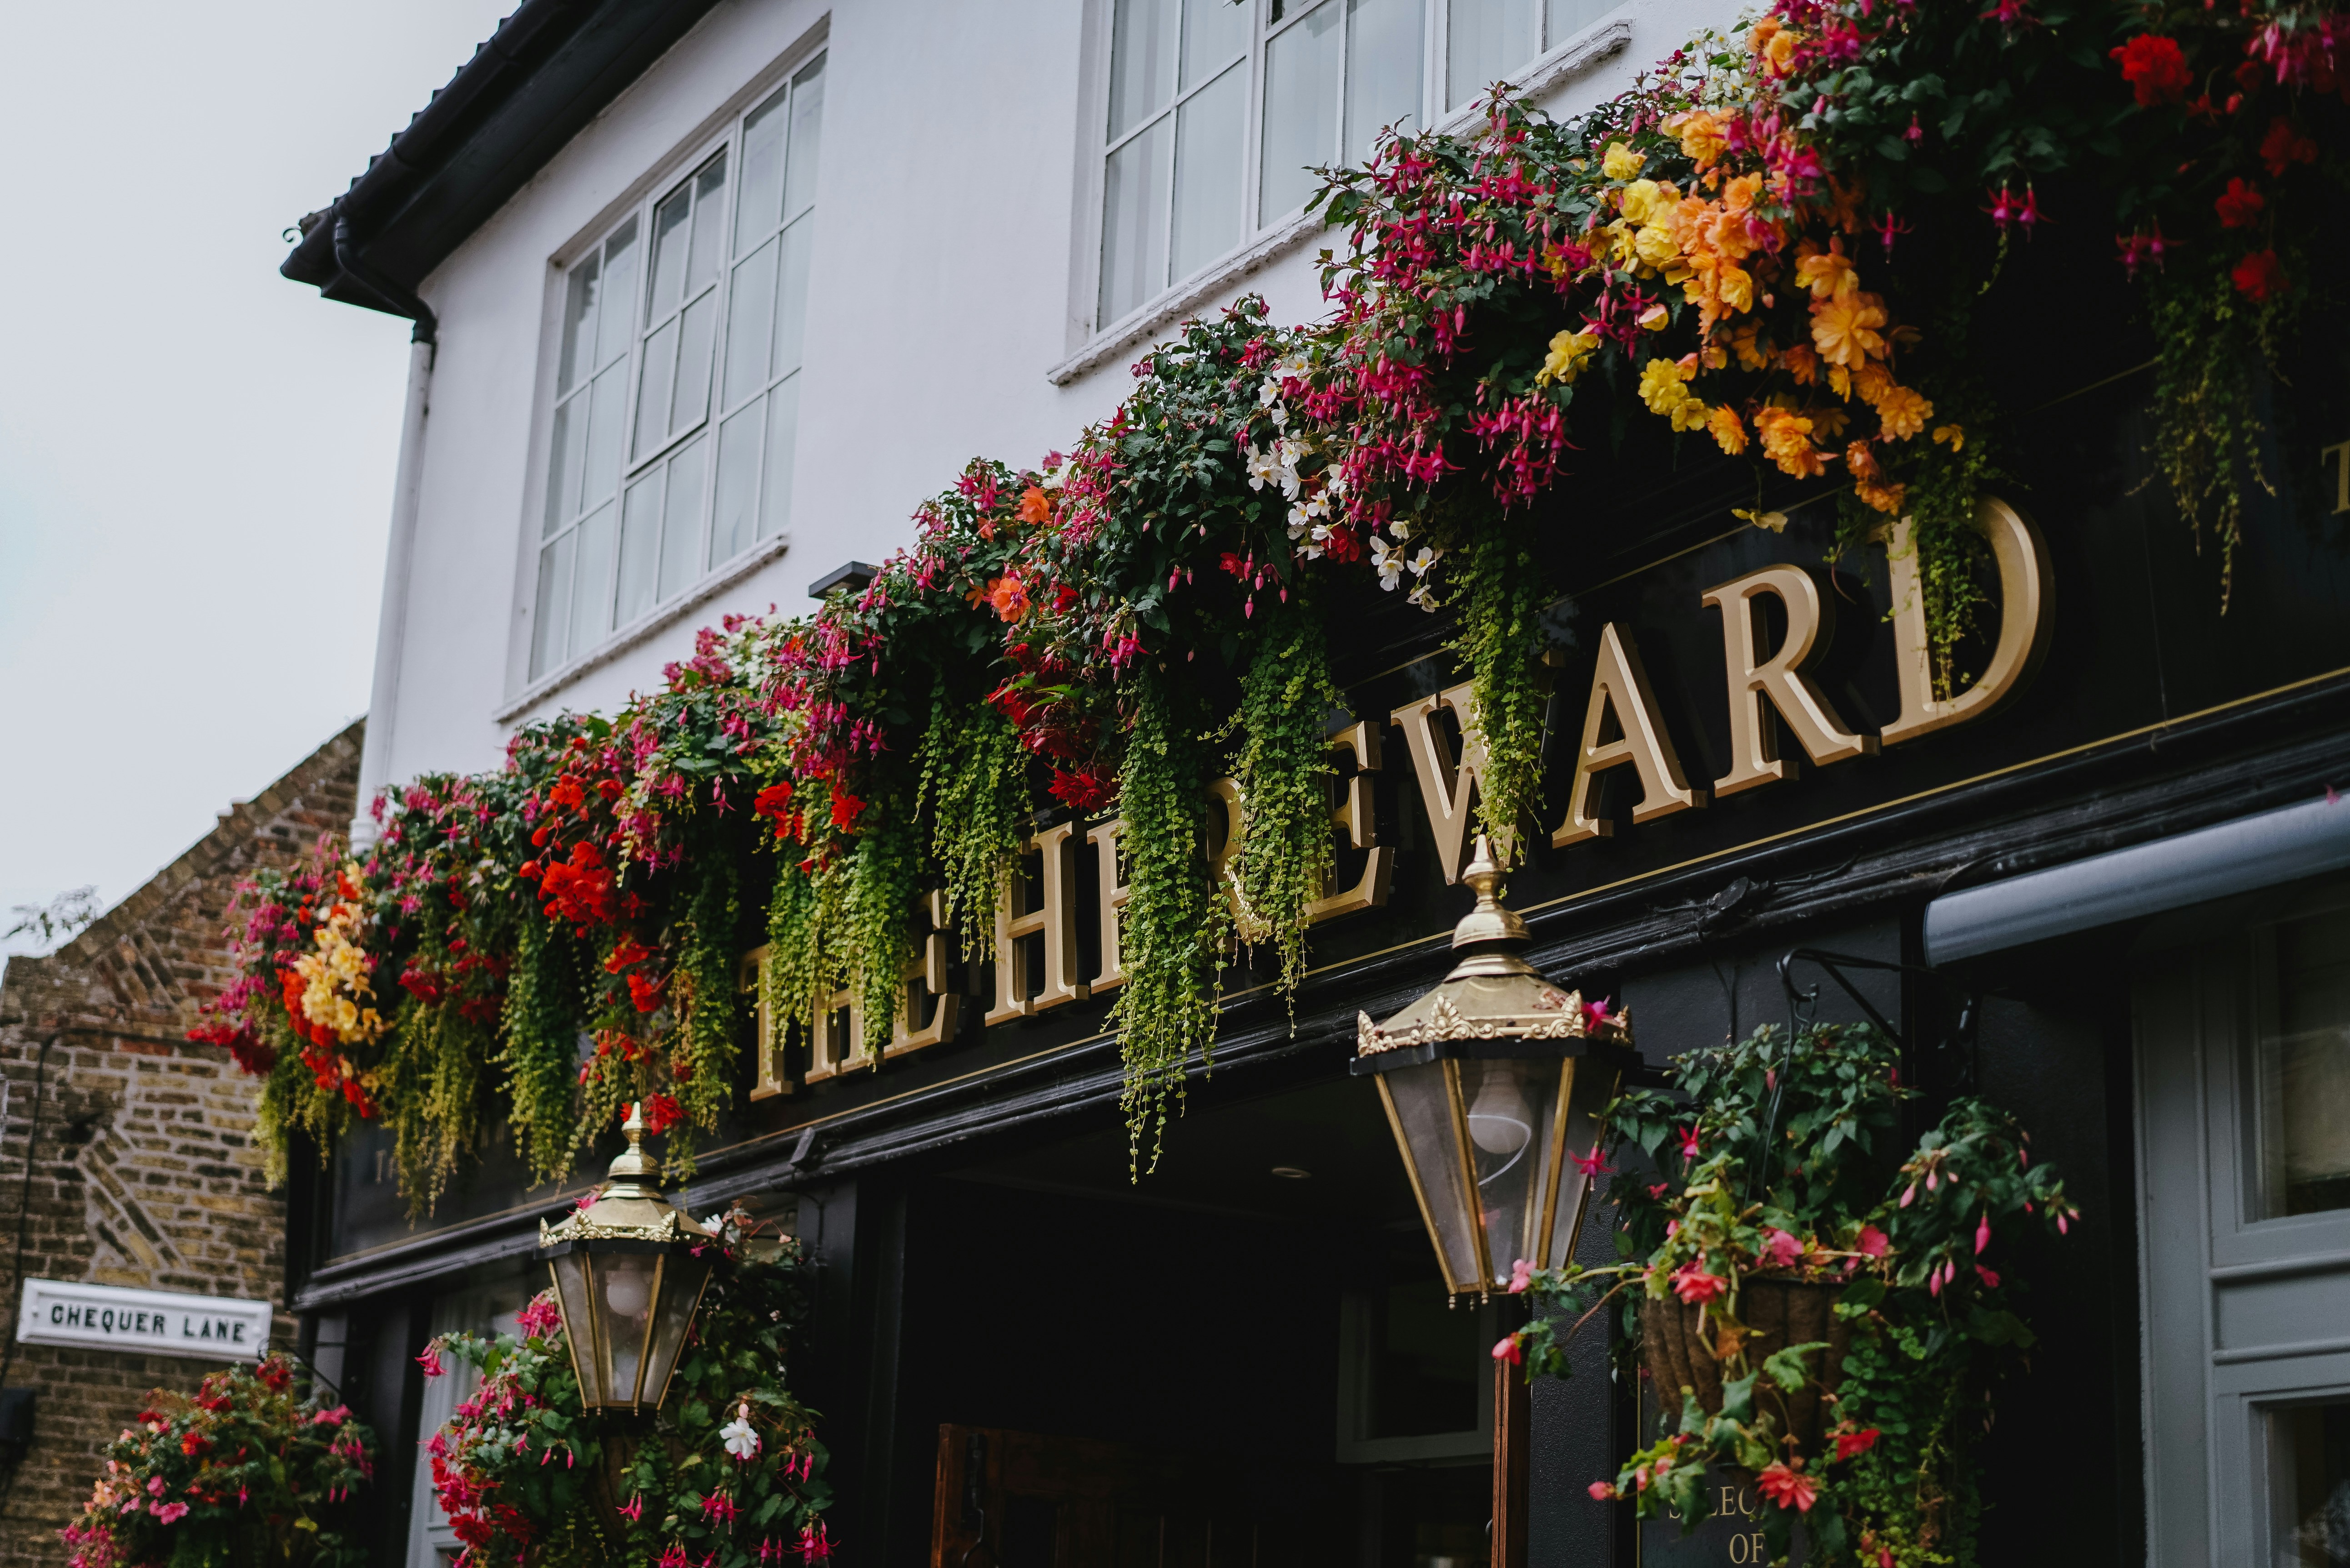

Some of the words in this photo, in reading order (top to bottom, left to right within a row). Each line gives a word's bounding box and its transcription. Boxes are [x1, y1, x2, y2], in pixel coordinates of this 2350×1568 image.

[51, 1303, 165, 1334] CHEQUER
[183, 1315, 246, 1342] LANE
[1729, 1533, 1766, 1564] OF
